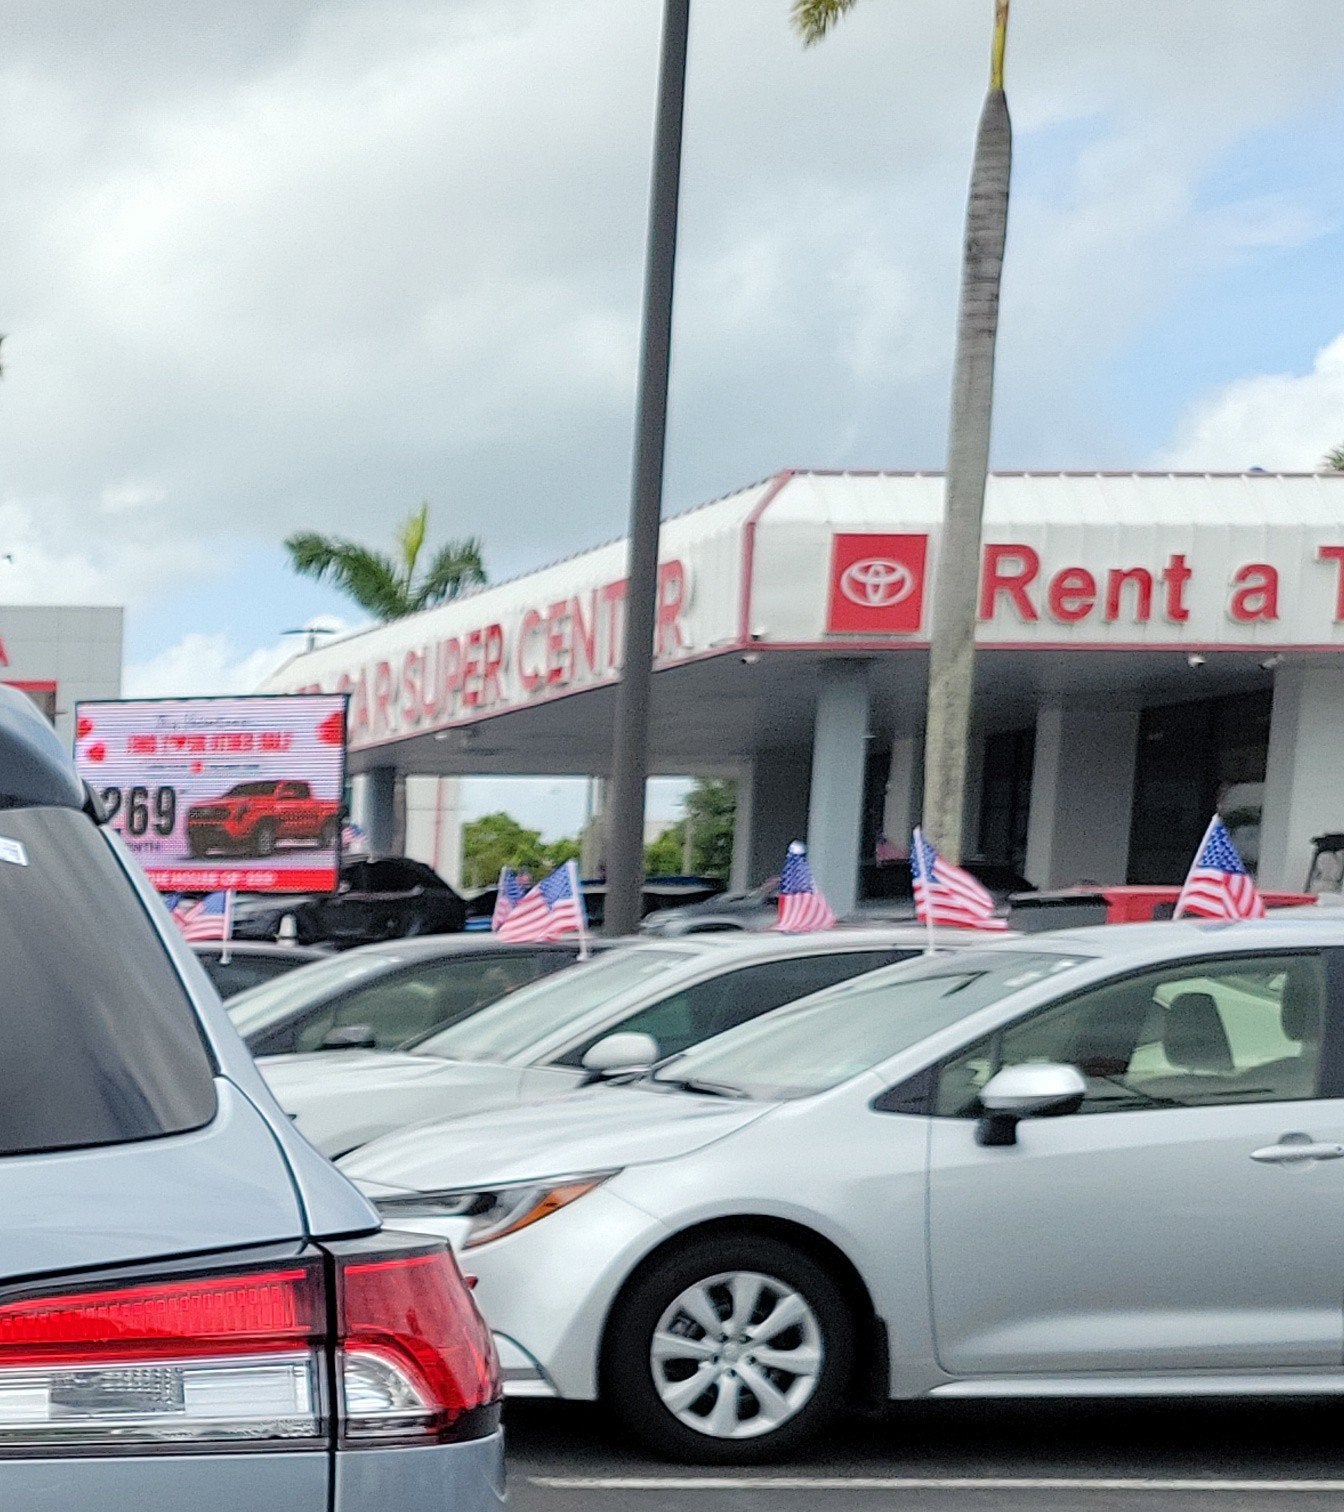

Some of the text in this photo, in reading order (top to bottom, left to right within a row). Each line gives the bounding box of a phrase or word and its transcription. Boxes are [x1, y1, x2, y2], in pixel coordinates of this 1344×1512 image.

[402, 622, 504, 722] SUPER
[516, 558, 688, 694] CENTR
[979, 543, 1193, 623] Rent
[1229, 563, 1280, 622] a
